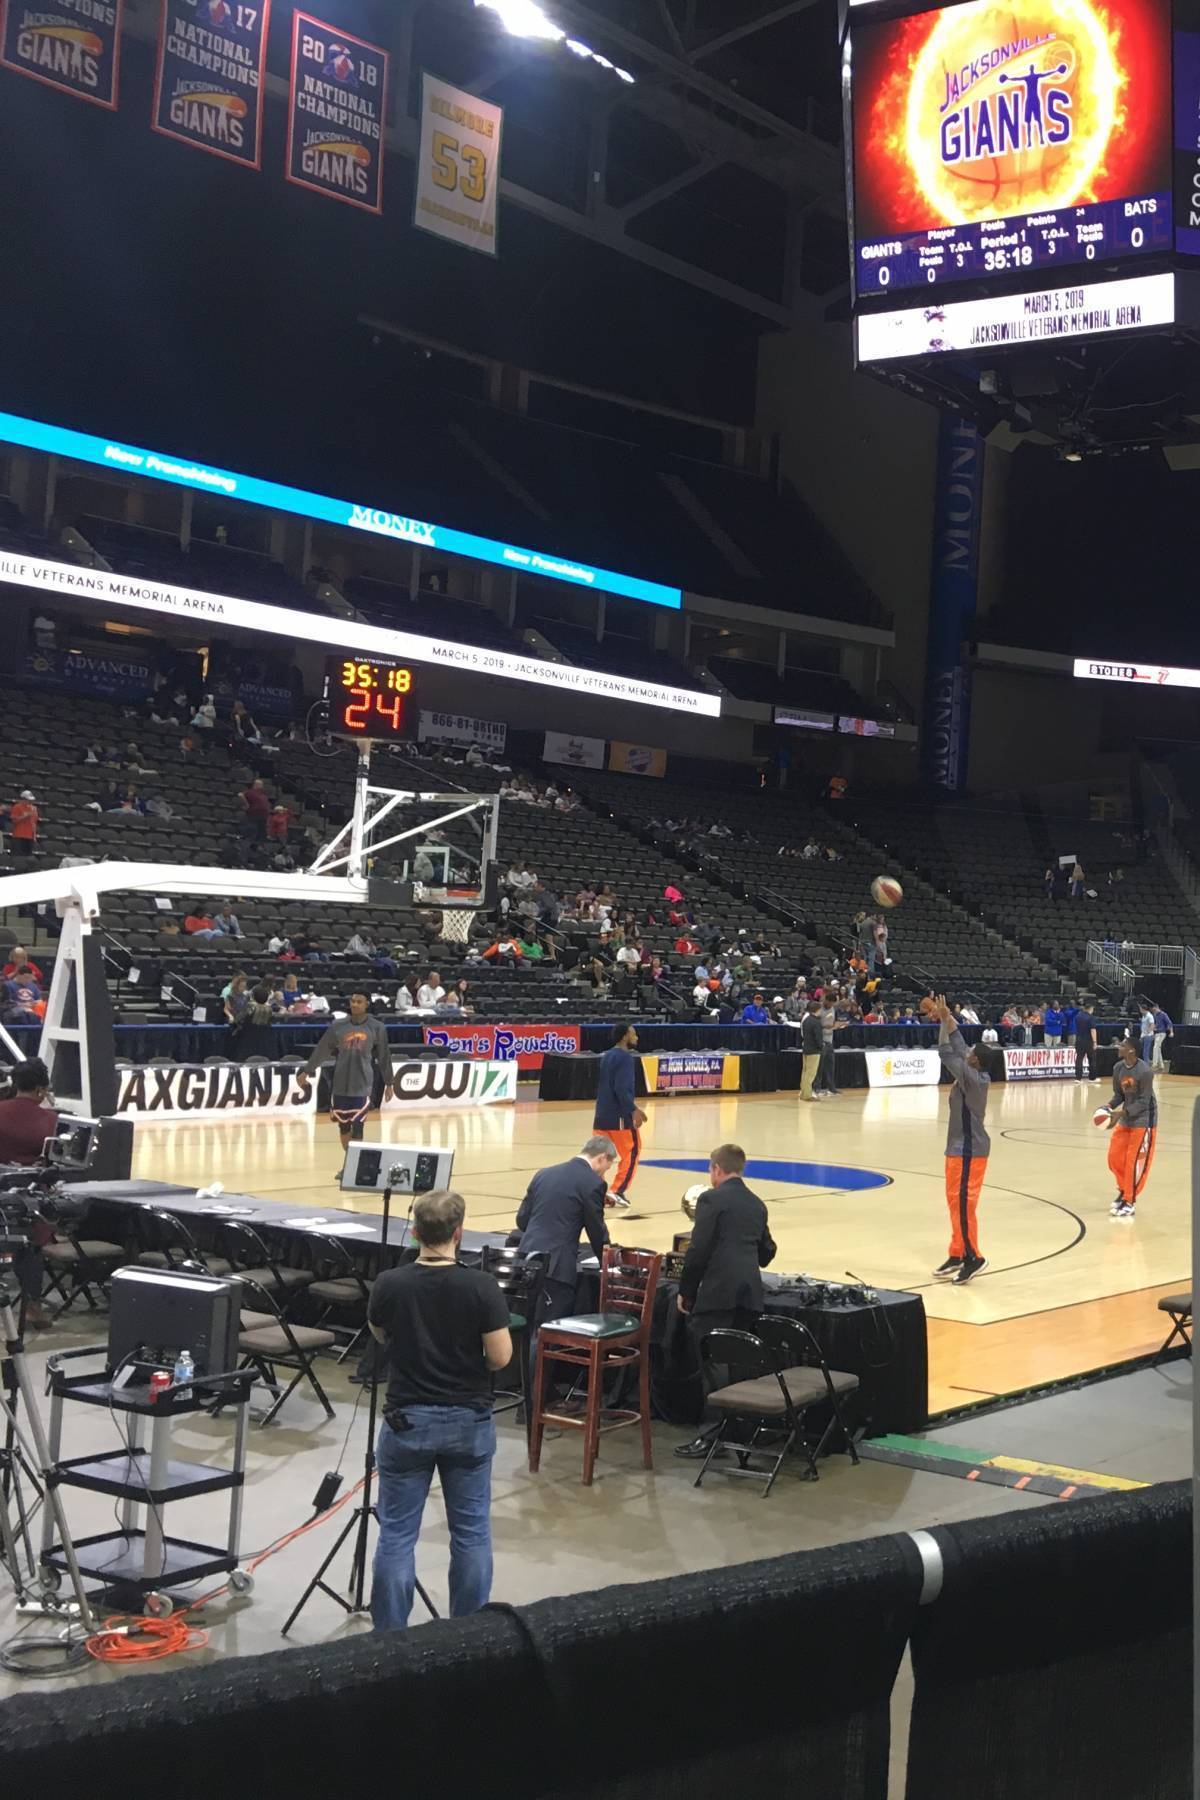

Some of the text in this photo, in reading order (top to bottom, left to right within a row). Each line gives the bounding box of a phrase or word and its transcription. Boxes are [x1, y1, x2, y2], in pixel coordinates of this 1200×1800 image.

[236, 5, 257, 31] 17
[175, 17, 253, 66] NATIONAL
[167, 35, 259, 87] CHAMPIONS
[302, 35, 377, 87] 20 18
[940, 32, 1056, 112] JACKSONVILLE
[304, 74, 375, 118] NATIONAL
[170, 99, 244, 147] GIANTS
[298, 92, 380, 139] CHAMPIONS
[941, 82, 1070, 162] GIANTS
[302, 150, 368, 194] GIANTS
[431, 129, 487, 203] 53
[1125, 200, 1157, 217] BATS
[861, 241, 902, 259] GIANTS
[981, 231, 1026, 249] Period 1
[1048, 241, 1056, 254] 3
[1086, 245, 1094, 259] 0
[1131, 227, 1143, 247] 0
[956, 254, 964, 267] 3
[984, 247, 1032, 271] 35:18
[879, 266, 889, 285] 0
[928, 269, 935, 282] 0
[1024, 295, 1051, 315] MARCH
[1065, 290, 1084, 309] 2019
[970, 305, 1142, 344] JACKSONVILLE VETERANS MEMORIAL ARENA
[104, 445, 143, 466] New
[352, 504, 437, 539] MONEY
[33, 567, 104, 591] VETERANS
[109, 583, 178, 605] MEMORIAL
[183, 597, 225, 614] ARENA
[342, 662, 411, 692] 35:18
[432, 646, 469, 661] MARCH
[483, 656, 505, 669] 2019
[514, 662, 582, 685] JACKSONVILLE
[583, 676, 627, 693] VETERANS
[628, 686, 671, 703] MEMORIAL
[672, 694, 699, 708] ARENA
[1090, 664, 1134, 677] STONES
[345, 688, 400, 729] 24
[494, 1026, 576, 1061] Rowdies
[1006, 1051, 1024, 1067] YOU
[1026, 1050, 1051, 1066] HURT?
[1054, 1050, 1065, 1065] WE
[394, 1062, 510, 1100] CW 17
[406, 1078, 420, 1086] THE
